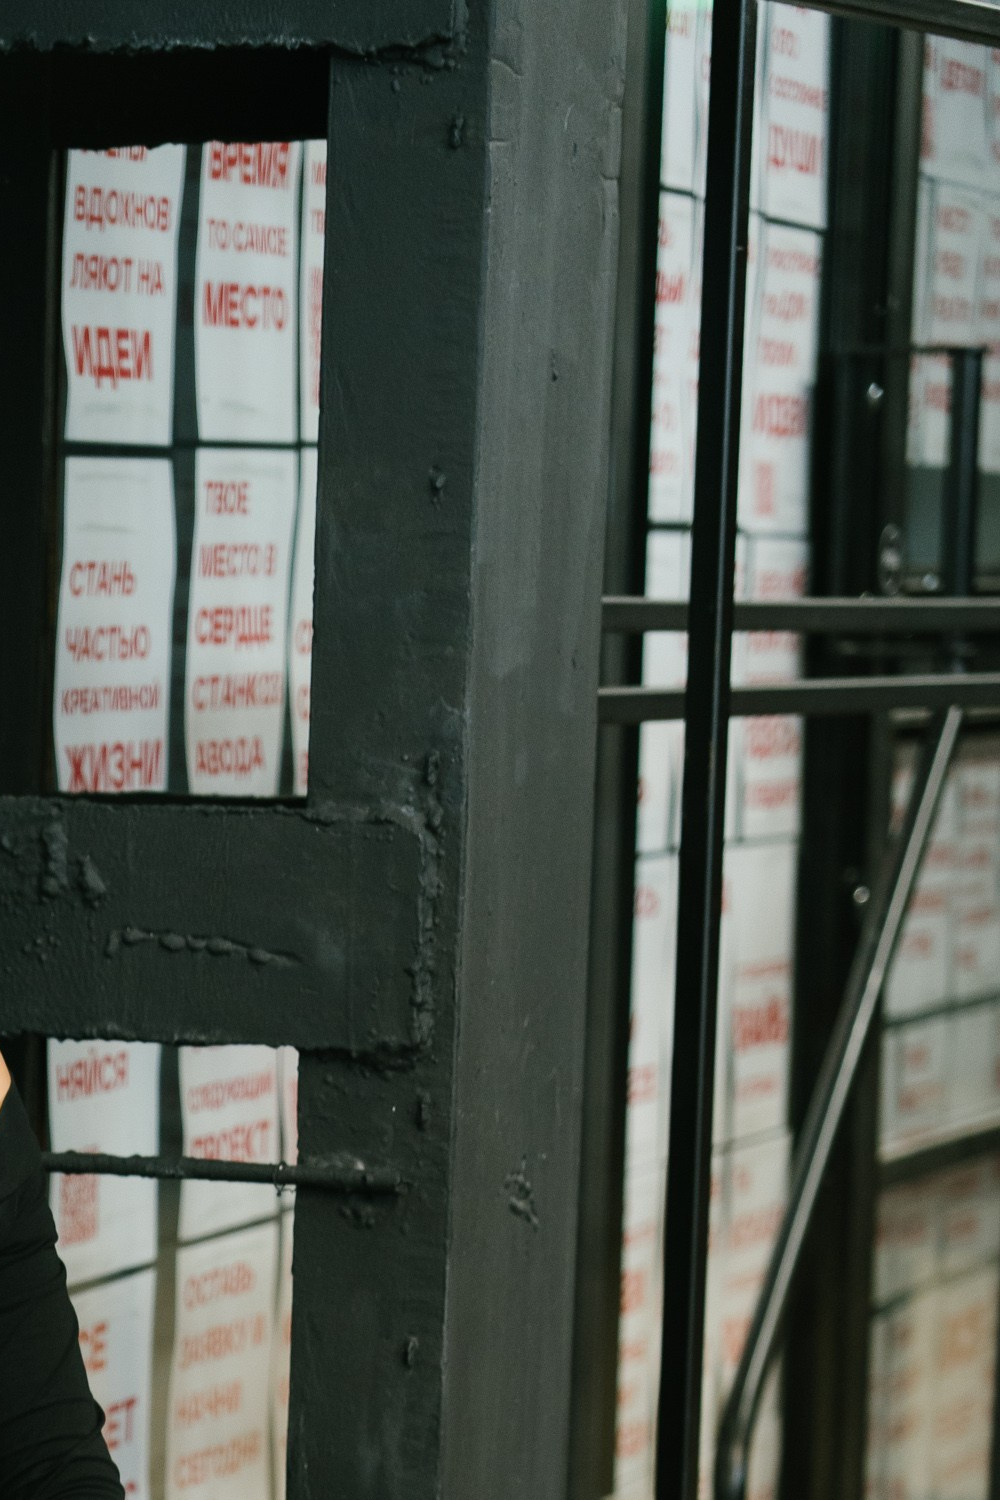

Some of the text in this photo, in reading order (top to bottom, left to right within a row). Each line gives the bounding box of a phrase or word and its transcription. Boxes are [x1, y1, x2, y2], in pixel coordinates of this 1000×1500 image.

[75, 184, 170, 232] ВДОХНОВ
[207, 217, 227, 250] ТО
[70, 253, 164, 295] ЛЯЮТ НА
[203, 281, 287, 331] МЕСТО
[71, 324, 153, 390] ИДЕИ
[69, 560, 136, 597] СТАНЬ
[66, 624, 149, 662] ЧАСТЬЮ
[196, 604, 273, 647] СЕРДЦЕ
[65, 739, 162, 791] ЖИЗНИ
